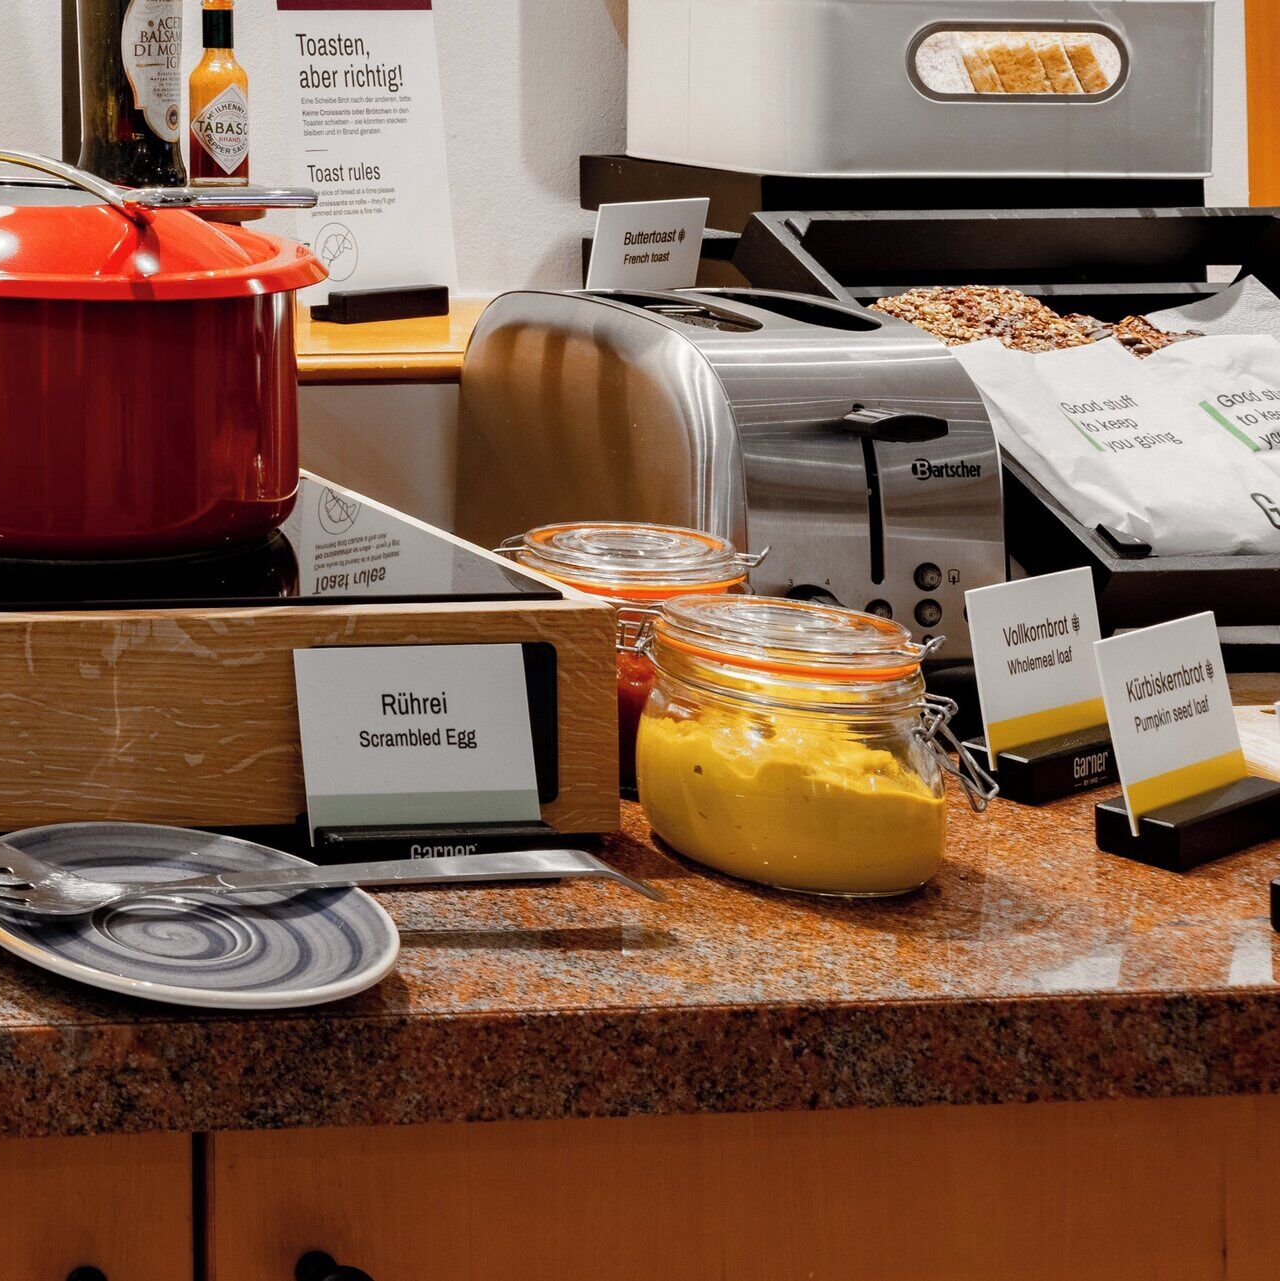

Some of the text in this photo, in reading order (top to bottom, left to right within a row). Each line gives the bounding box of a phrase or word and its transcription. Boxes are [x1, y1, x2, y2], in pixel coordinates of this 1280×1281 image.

[134, 44, 152, 56] DI
[295, 34, 370, 60] Toasten,
[300, 63, 403, 92] aber richtig!
[197, 120, 248, 135] TABASC
[205, 134, 231, 154] PEPPER
[307, 162, 380, 182] Toast rules
[624, 229, 676, 245] Buttertoast
[624, 251, 670, 265] French toast
[1060, 395, 1139, 414] Good stuff
[1216, 389, 1262, 408] Good
[1080, 418, 1138, 432] to keep
[1236, 414, 1258, 426] to
[1102, 432, 1183, 453] you going
[911, 458, 982, 481] Bartscher
[788, 579, 793, 587] 3
[825, 578, 830, 586] 4
[1003, 616, 1069, 646] Vollkornbrot
[1007, 645, 1072, 675] Wholemeal loaf
[1126, 661, 1205, 703] Kürbiskernbrot
[381, 692, 448, 715] Rührei
[1134, 694, 1210, 733] Pumpkin seed loaf
[359, 728, 477, 749] Scrambled Egg
[1074, 751, 1108, 778] Garner
